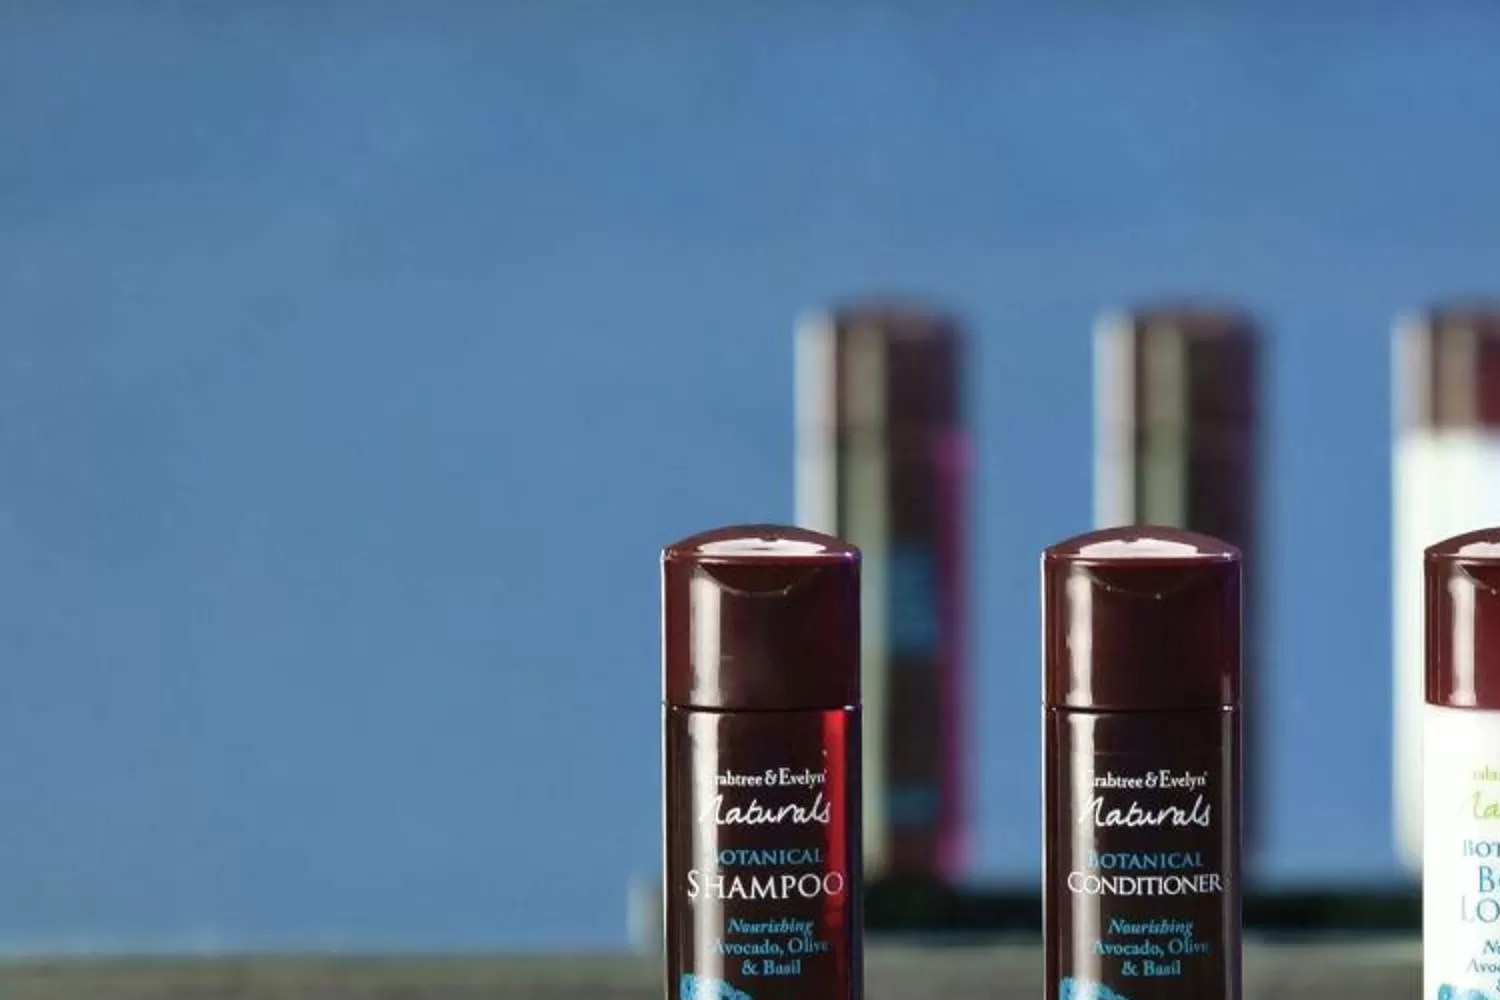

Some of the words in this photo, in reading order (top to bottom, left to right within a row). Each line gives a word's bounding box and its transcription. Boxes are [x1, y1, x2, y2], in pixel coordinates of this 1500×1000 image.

[713, 769, 762, 787] rabtree
[765, 769, 777, 786] &
[779, 767, 826, 791] Evelyn
[1093, 771, 1142, 788] rabtree
[1145, 771, 1158, 788] &
[1160, 769, 1206, 792] Evelyn
[687, 869, 843, 900] SHAMPOO
[1067, 871, 1223, 896] CONDITIONER
[728, 918, 813, 939] Nourishing
[1108, 918, 1193, 938] Nourishing
[1093, 939, 1165, 957] Avocado,
[741, 959, 759, 976] &
[763, 959, 801, 976] Basil
[1121, 960, 1138, 977] &
[1143, 959, 1181, 977] Basil
